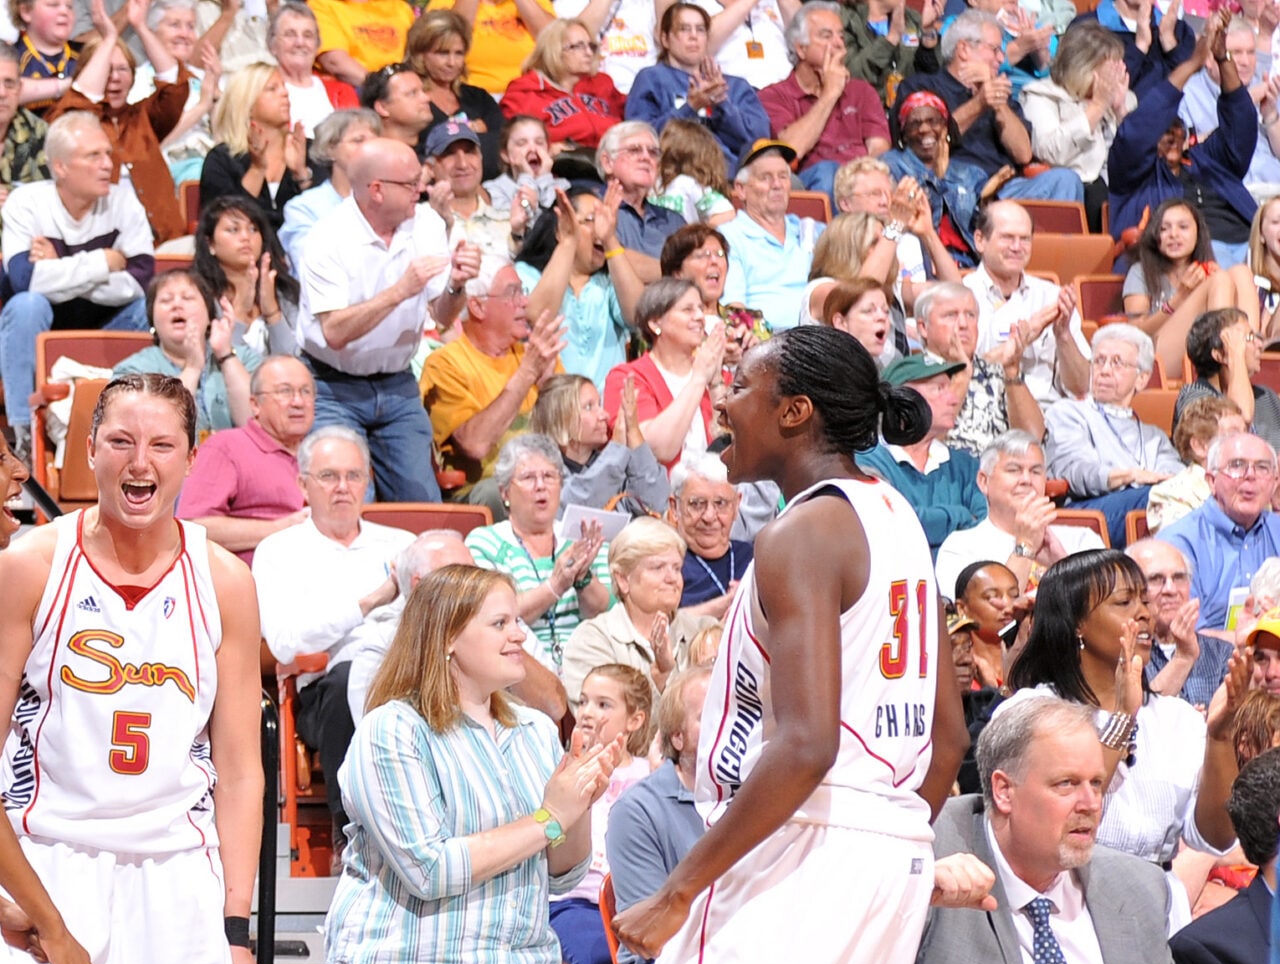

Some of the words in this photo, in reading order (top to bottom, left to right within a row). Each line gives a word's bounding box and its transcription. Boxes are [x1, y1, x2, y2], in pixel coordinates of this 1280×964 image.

[60, 628, 195, 704] Sun
[879, 579, 927, 680] 31
[109, 710, 151, 775] 5
